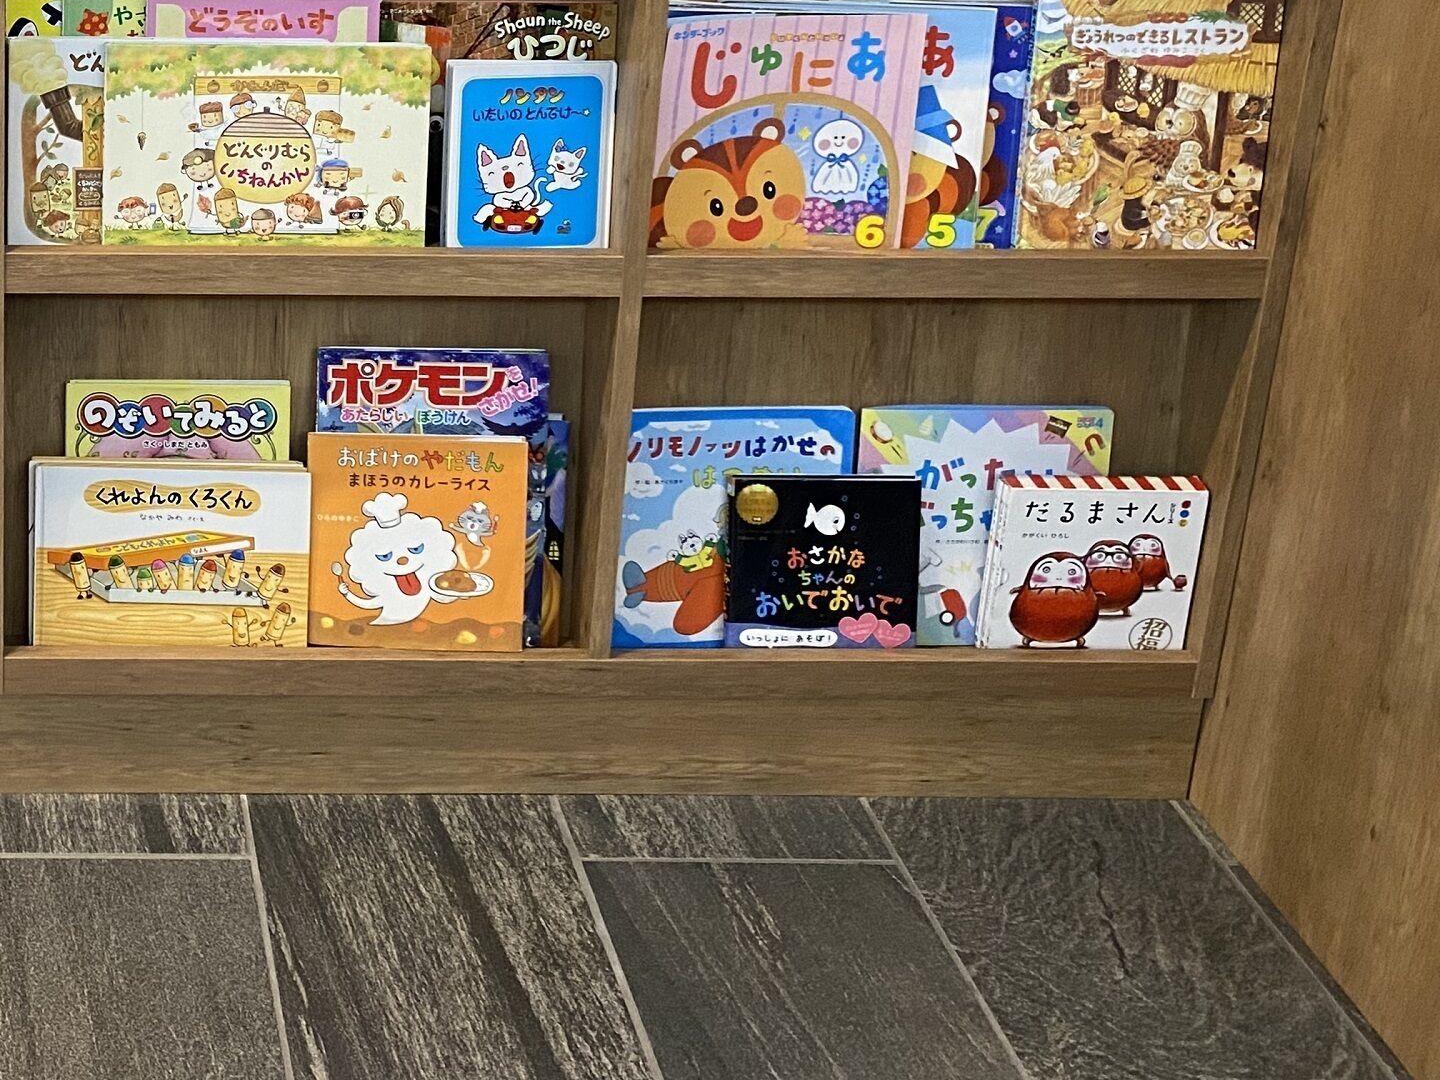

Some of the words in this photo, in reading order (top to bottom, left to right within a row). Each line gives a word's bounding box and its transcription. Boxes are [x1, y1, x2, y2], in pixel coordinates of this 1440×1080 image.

[187, 6, 335, 35] どうぞのいす
[494, 15, 546, 39] Shaun
[548, 17, 562, 26] the
[563, 11, 611, 41] Sheep
[506, 34, 594, 61] ひつじ
[1074, 27, 1245, 46] ぎょうれつのできるレストラン
[691, 30, 886, 110] じゅにあ
[499, 86, 566, 105] ノンタン
[222, 140, 311, 163] どんぐりむら
[218, 166, 310, 189] いちねんかん
[261, 160, 273, 171] の
[854, 213, 886, 249] 6
[925, 212, 957, 249] 5
[975, 207, 999, 242] 7
[328, 360, 510, 408] ポケモン
[83, 399, 268, 434] のぞいてみると
[336, 446, 505, 473] おばけのやだもん
[348, 472, 491, 492] まほうのカレーライス
[1025, 500, 1166, 524] だるまさん
[787, 545, 866, 569] おさかな
[798, 570, 856, 586] ちゃんの
[755, 585, 904, 618] おいでおいで
[746, 634, 789, 643] いっしょに
